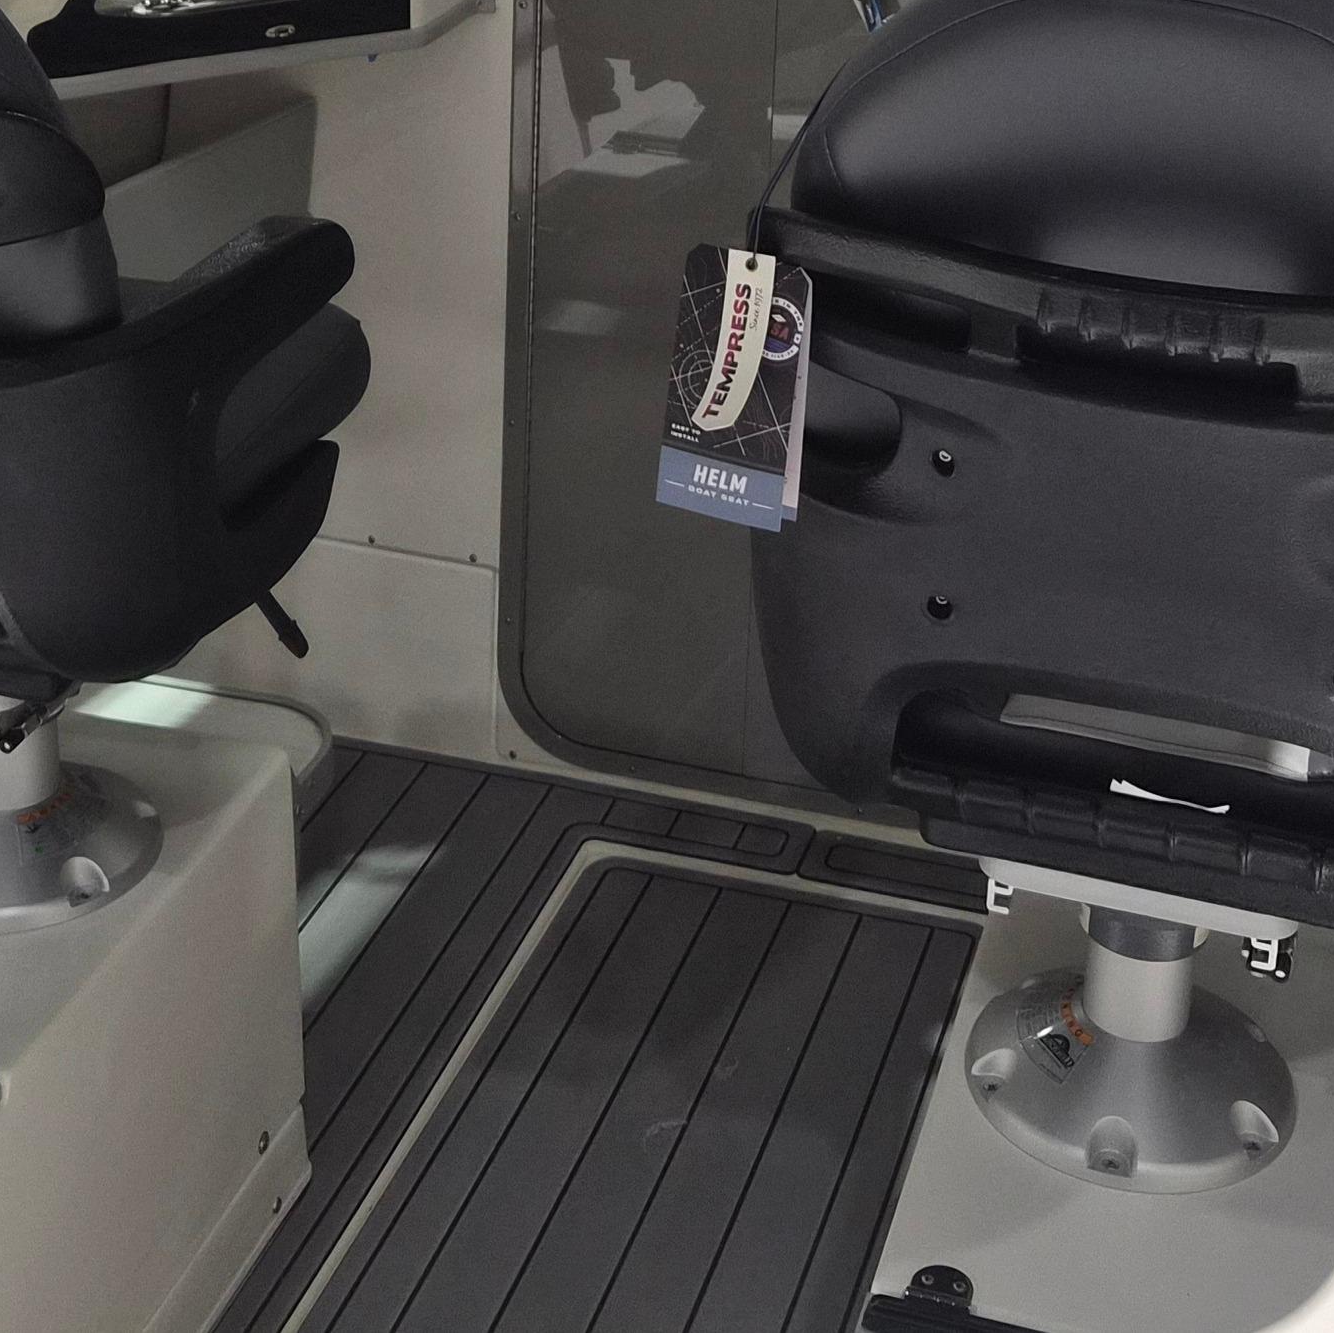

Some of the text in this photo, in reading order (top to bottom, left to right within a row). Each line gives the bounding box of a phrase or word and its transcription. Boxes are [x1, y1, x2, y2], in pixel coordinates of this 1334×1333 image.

[701, 283, 752, 420] TEMPRESS
[693, 463, 747, 494] HELM
[688, 484, 749, 506] BOAT SEAT
